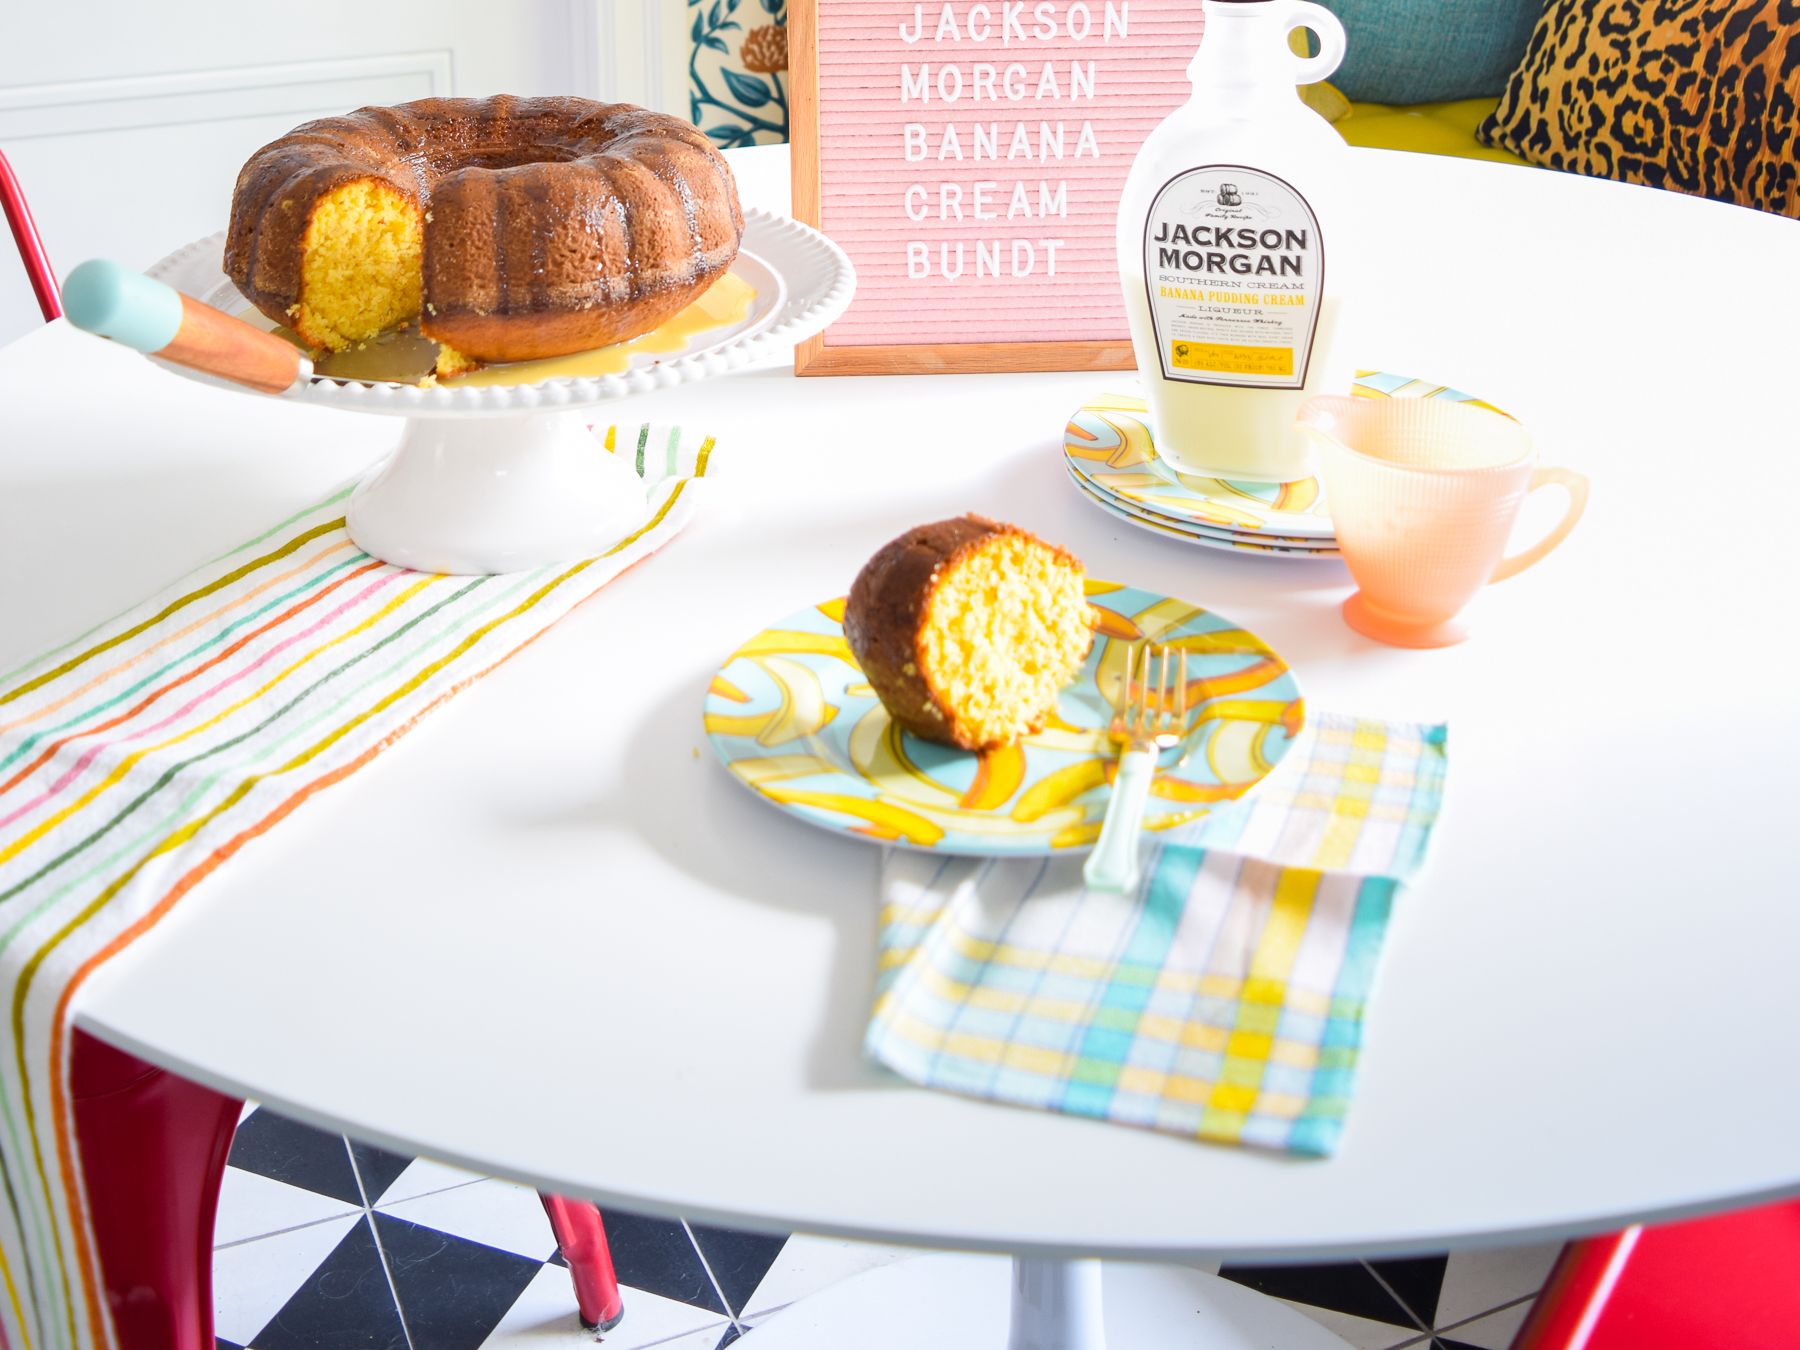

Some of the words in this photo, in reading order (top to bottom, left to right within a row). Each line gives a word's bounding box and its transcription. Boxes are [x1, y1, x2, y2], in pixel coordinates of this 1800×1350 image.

[899, 1, 1129, 46] JACKSON
[900, 61, 1096, 103] MORGAN
[903, 120, 1100, 163] BANANA
[904, 180, 1067, 221] CREAM
[1214, 207, 1243, 215] Original
[1154, 222, 1309, 251] JACKSON
[906, 239, 1065, 282] BUNDT
[1159, 247, 1304, 277] MORGAN
[1158, 274, 1242, 288] SOUTHERN
[1246, 281, 1305, 290] CREAM
[1160, 286, 1205, 302] BANANA
[1208, 290, 1259, 305] PUDDING
[1263, 293, 1305, 306] CREAM
[1198, 305, 1264, 316] LIQUEUR
[1253, 318, 1283, 327] Whiskey
